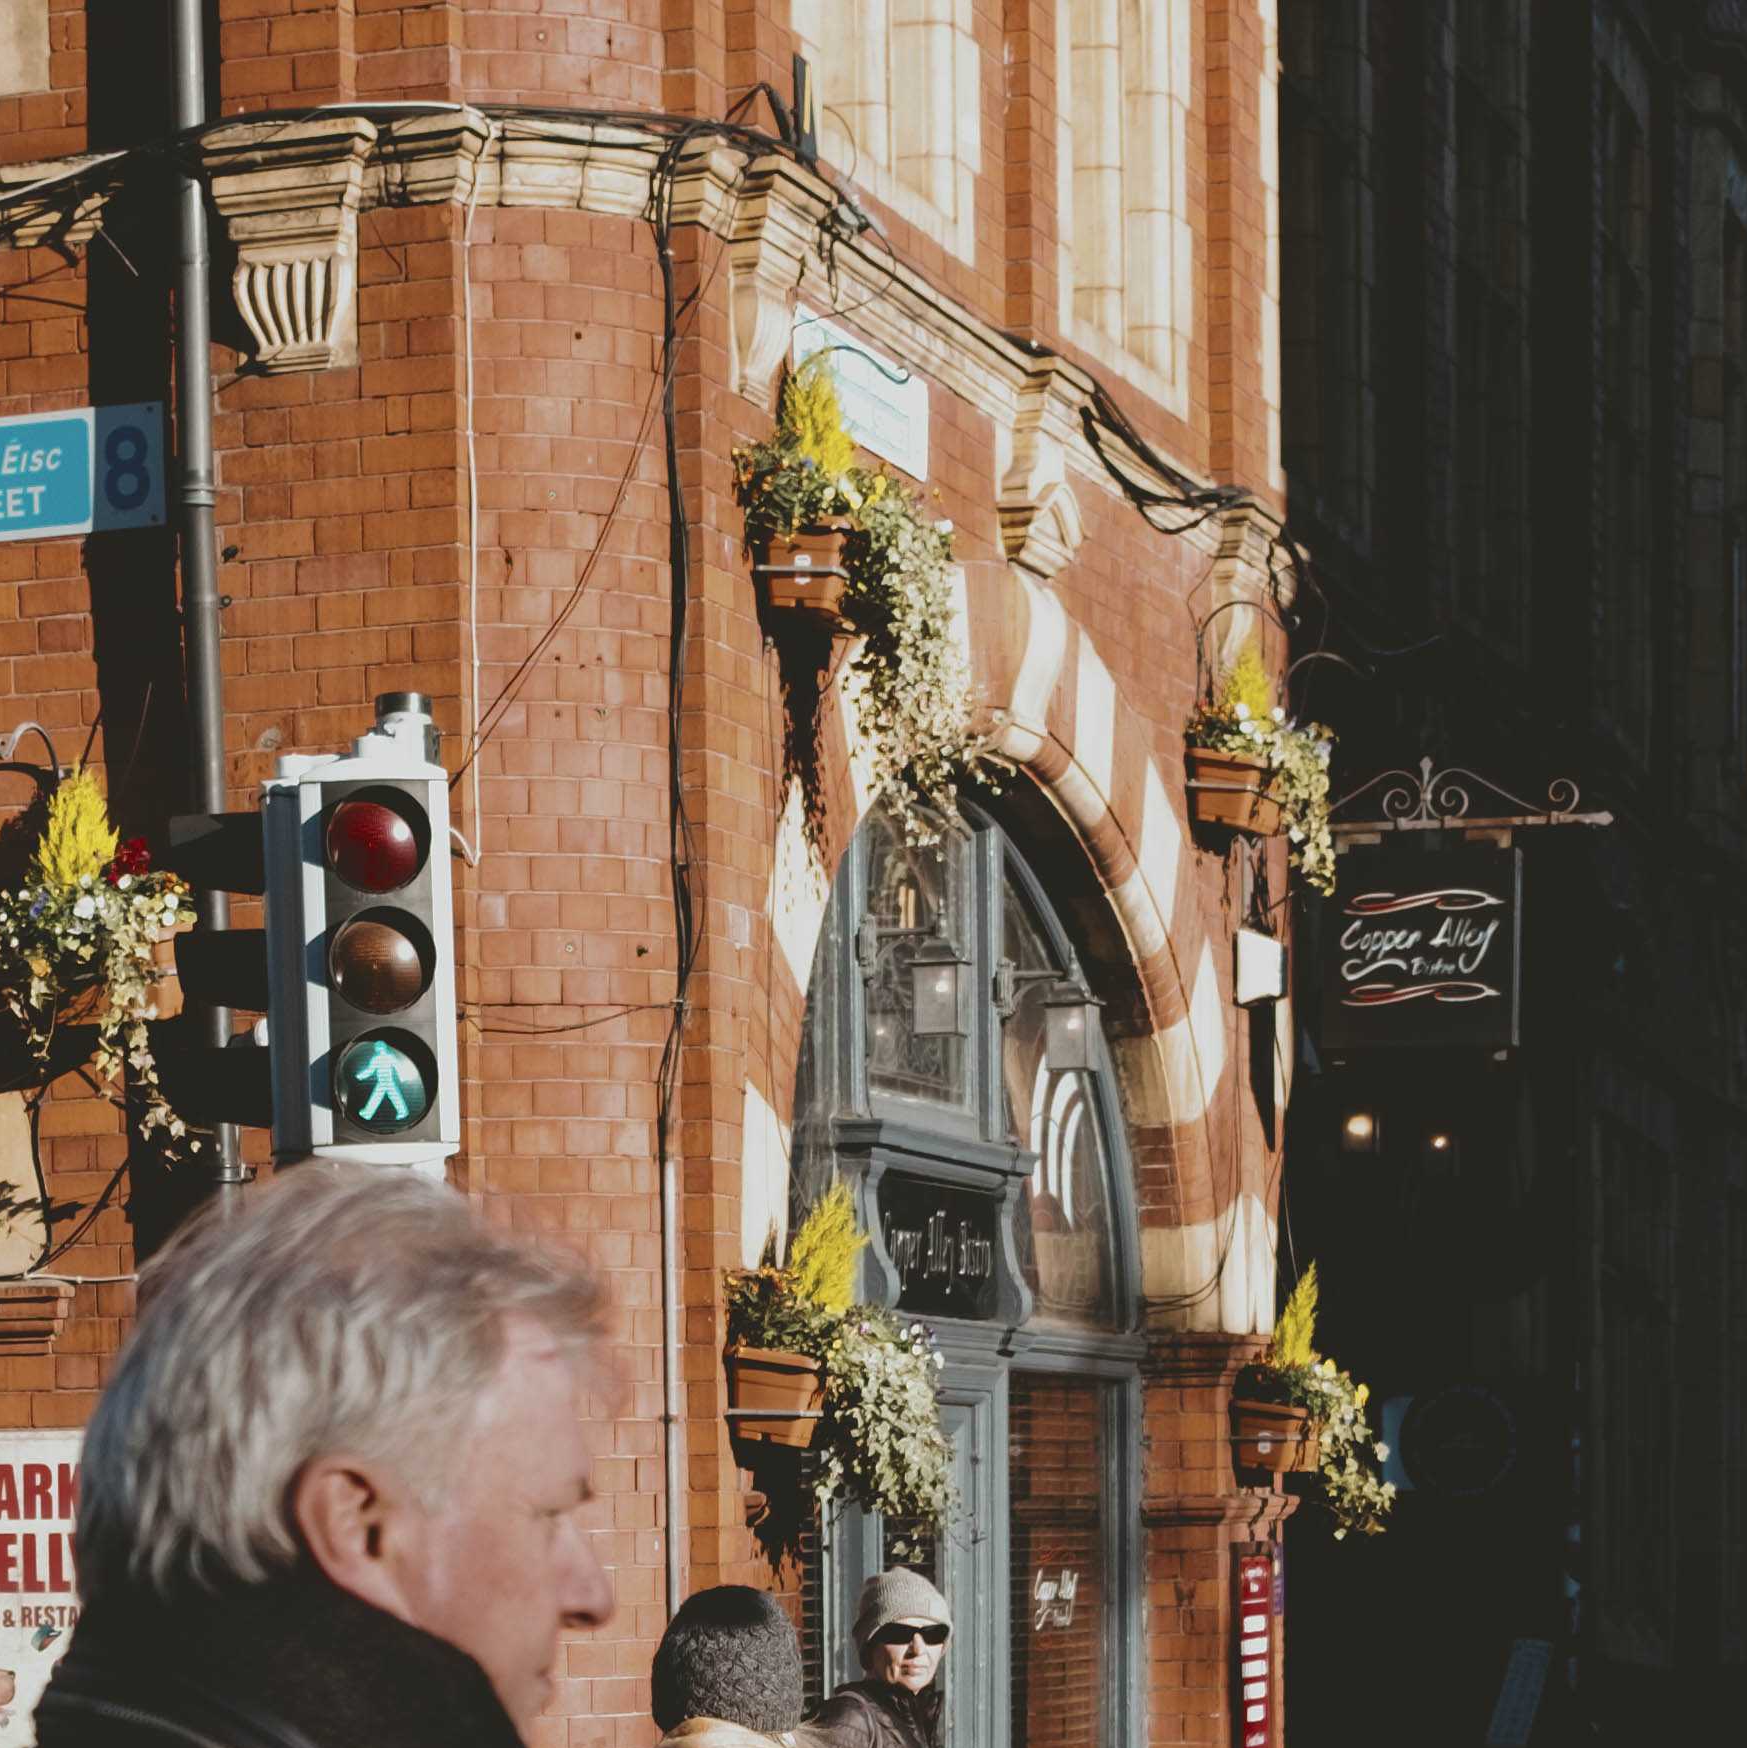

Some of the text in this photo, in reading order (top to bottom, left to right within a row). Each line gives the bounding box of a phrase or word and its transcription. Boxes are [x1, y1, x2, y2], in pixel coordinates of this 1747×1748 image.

[103, 425, 151, 511] 8
[1340, 915, 1500, 974] Copper Alley
[2, 1608, 15, 1628] &
